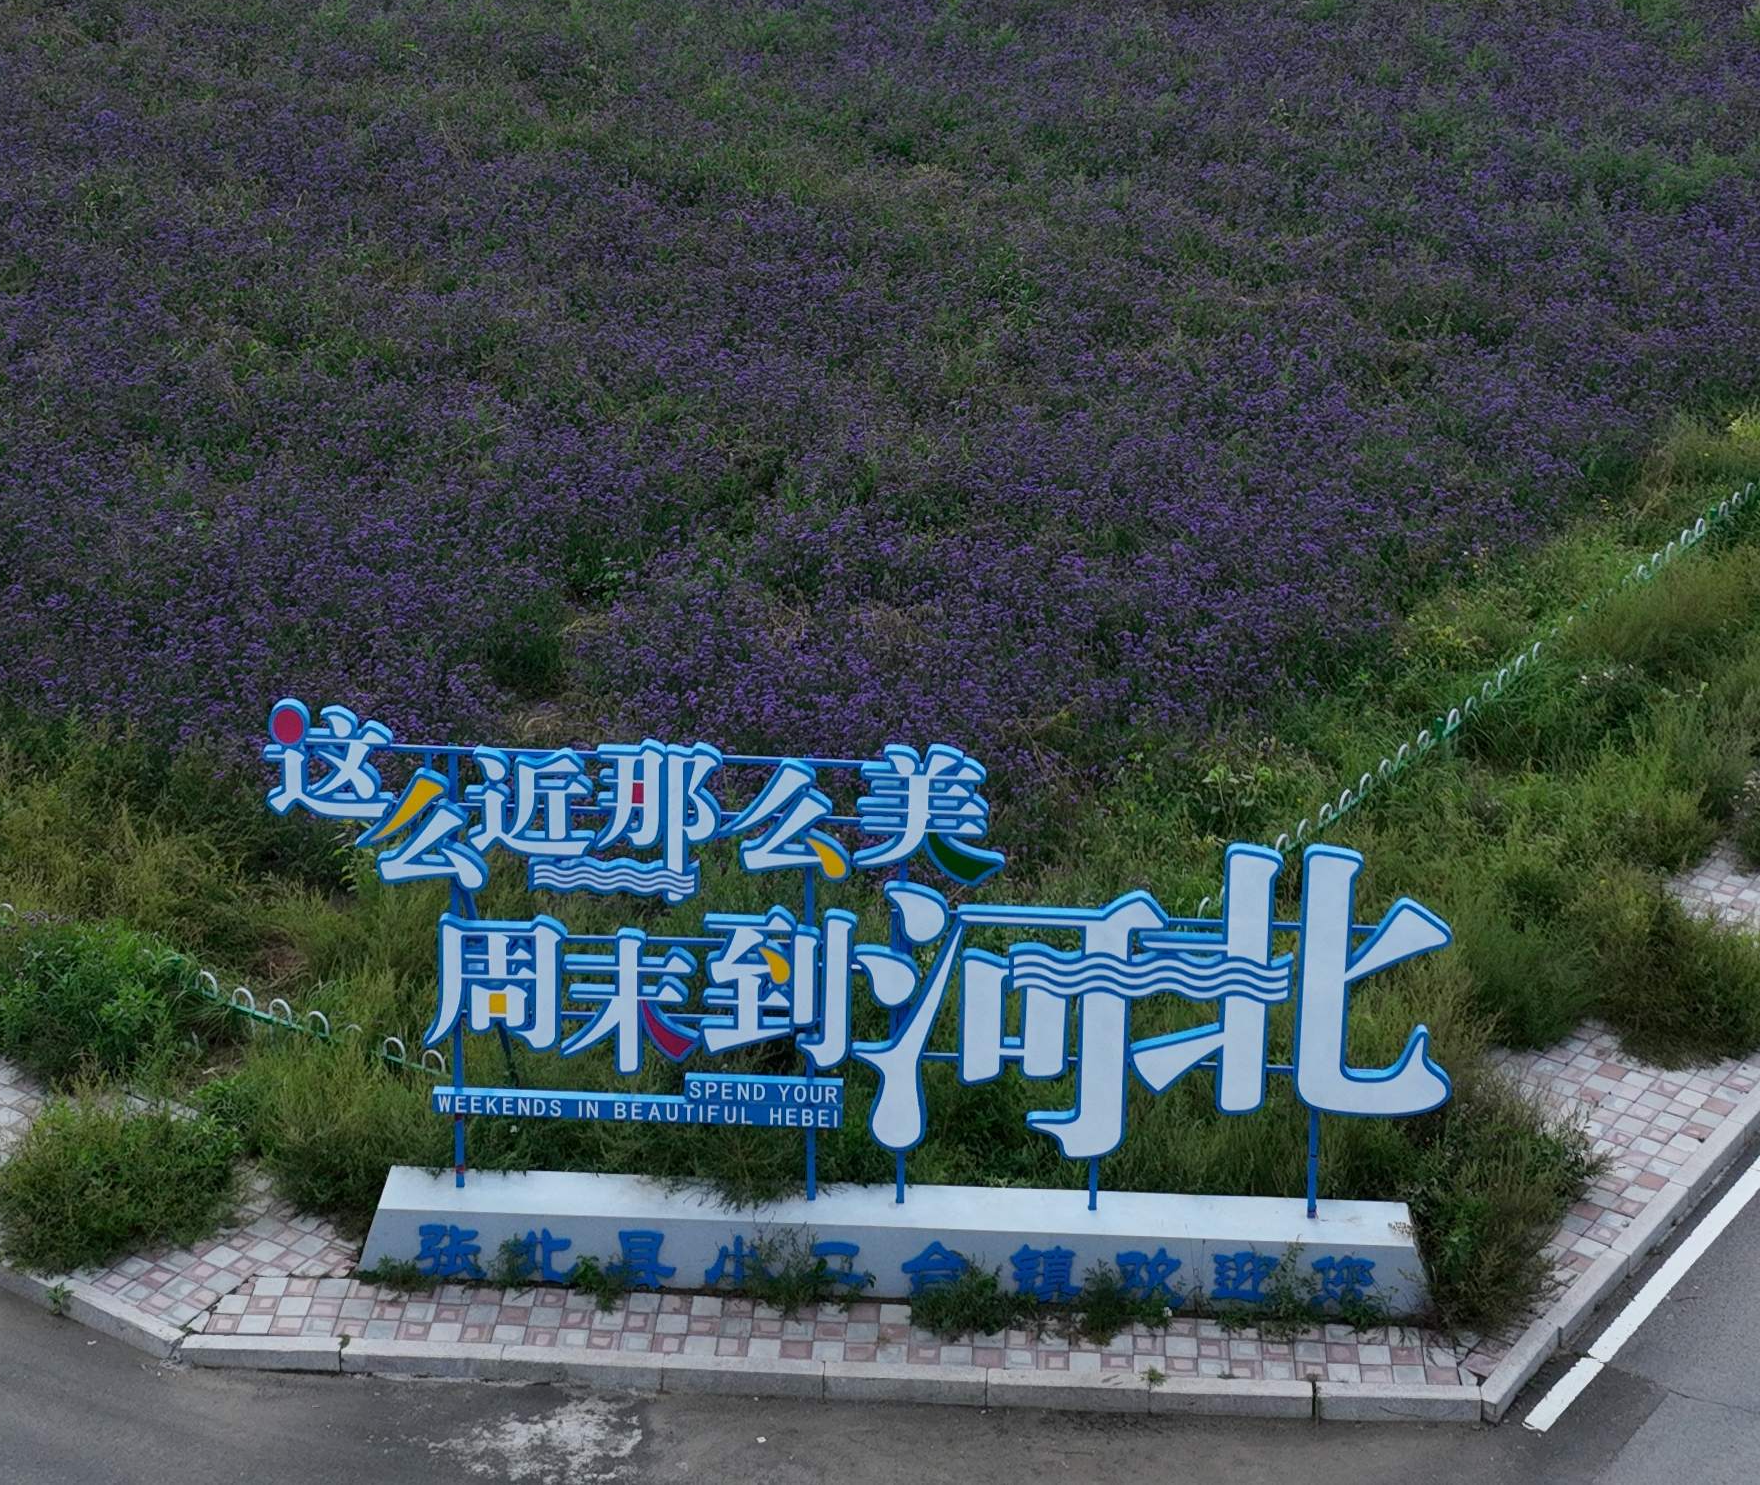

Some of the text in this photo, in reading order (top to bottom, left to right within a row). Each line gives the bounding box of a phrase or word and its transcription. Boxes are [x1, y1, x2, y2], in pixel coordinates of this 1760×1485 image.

[263, 697, 1006, 889] 这么近那么美
[424, 841, 1453, 1160] 周末到河北
[437, 1094, 840, 1129] WEEKENDS IN BEAUTIFUL HEBEI
[688, 1080, 840, 1105] SPEND YOUR
